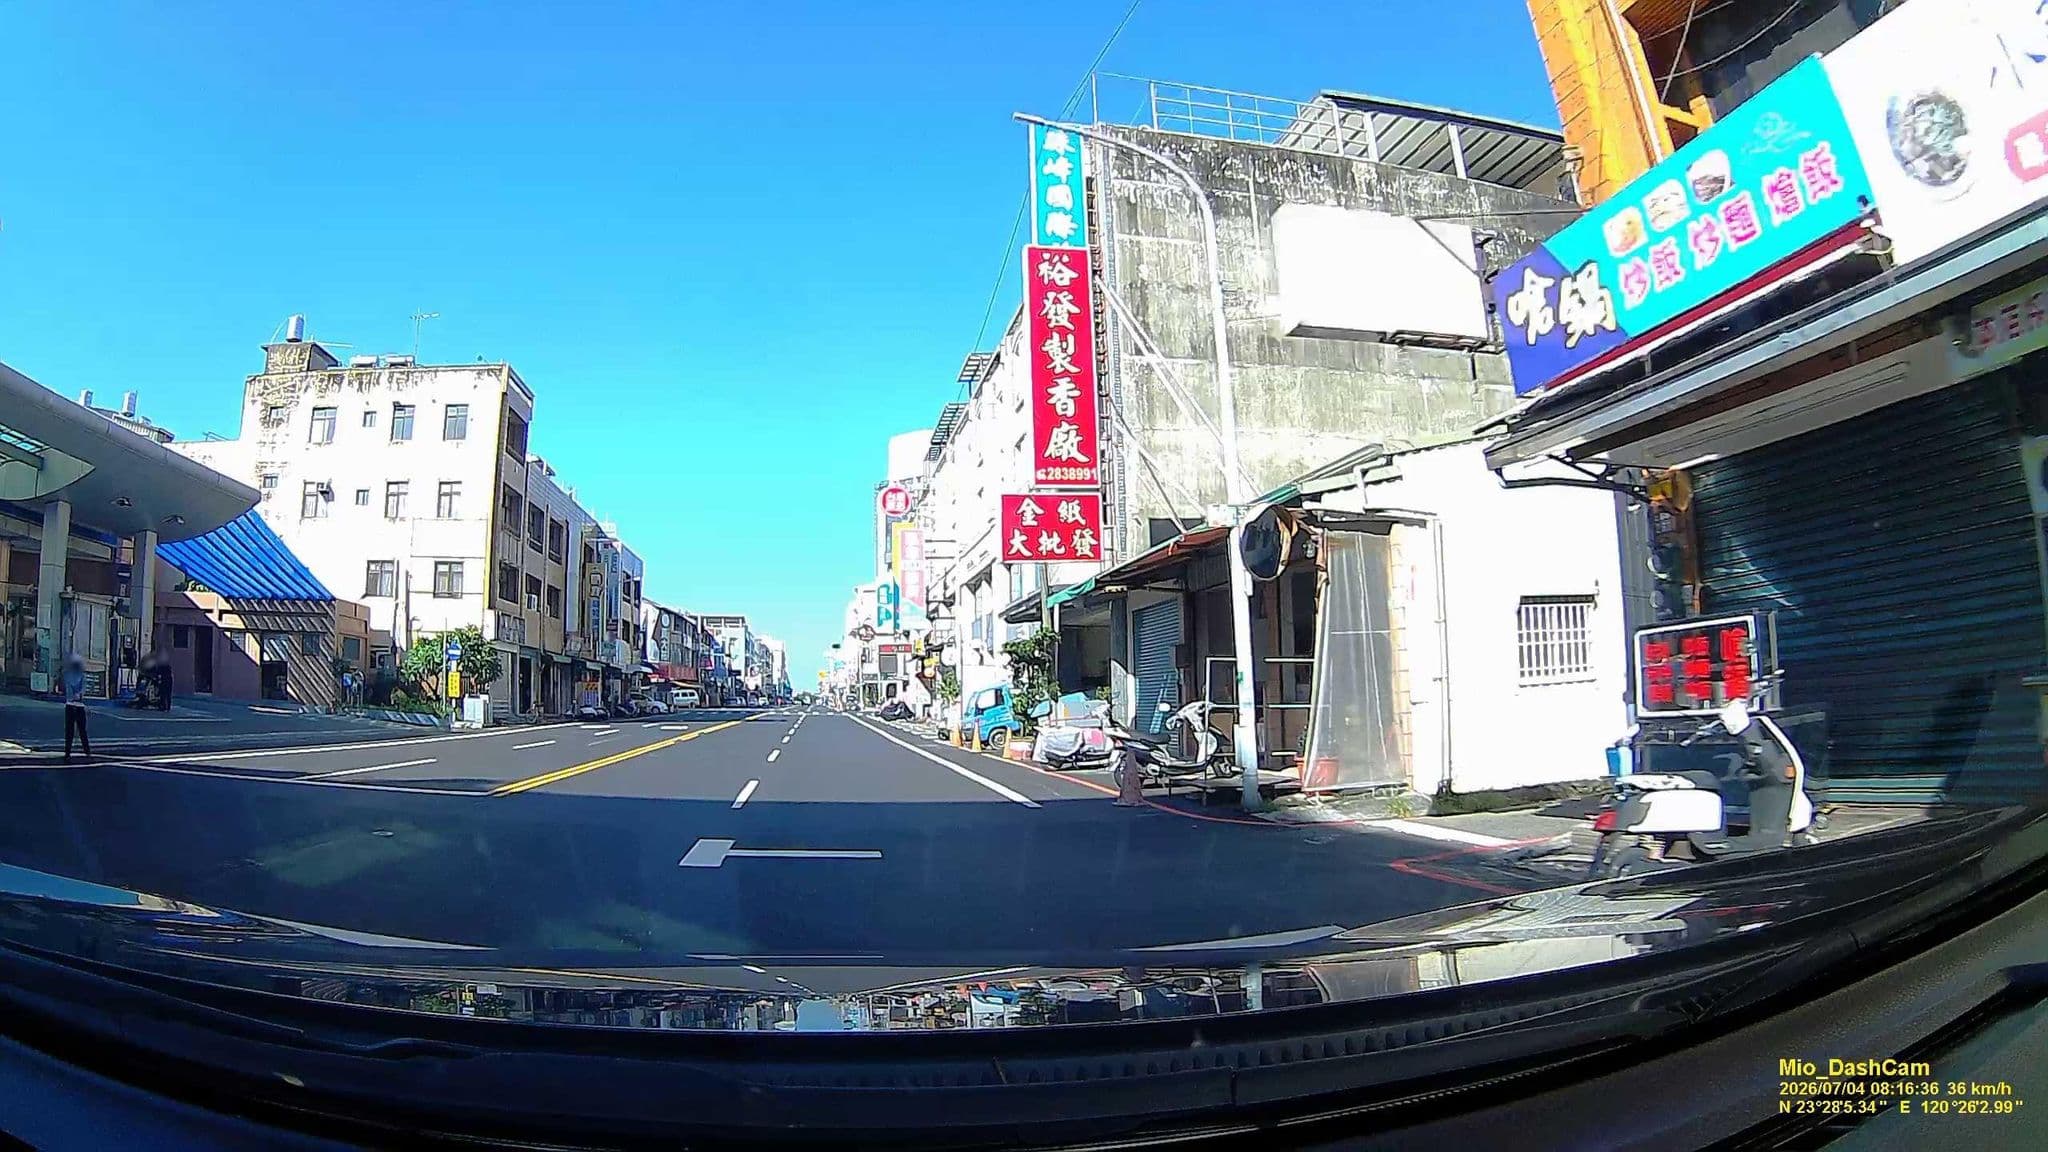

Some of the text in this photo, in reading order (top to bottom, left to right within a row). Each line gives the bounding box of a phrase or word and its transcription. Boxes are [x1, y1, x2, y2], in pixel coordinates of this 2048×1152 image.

[1037, 252, 1090, 464] 裕發製香廠
[1047, 466, 1097, 480] 2838991
[1007, 527, 1099, 559] 大批發
